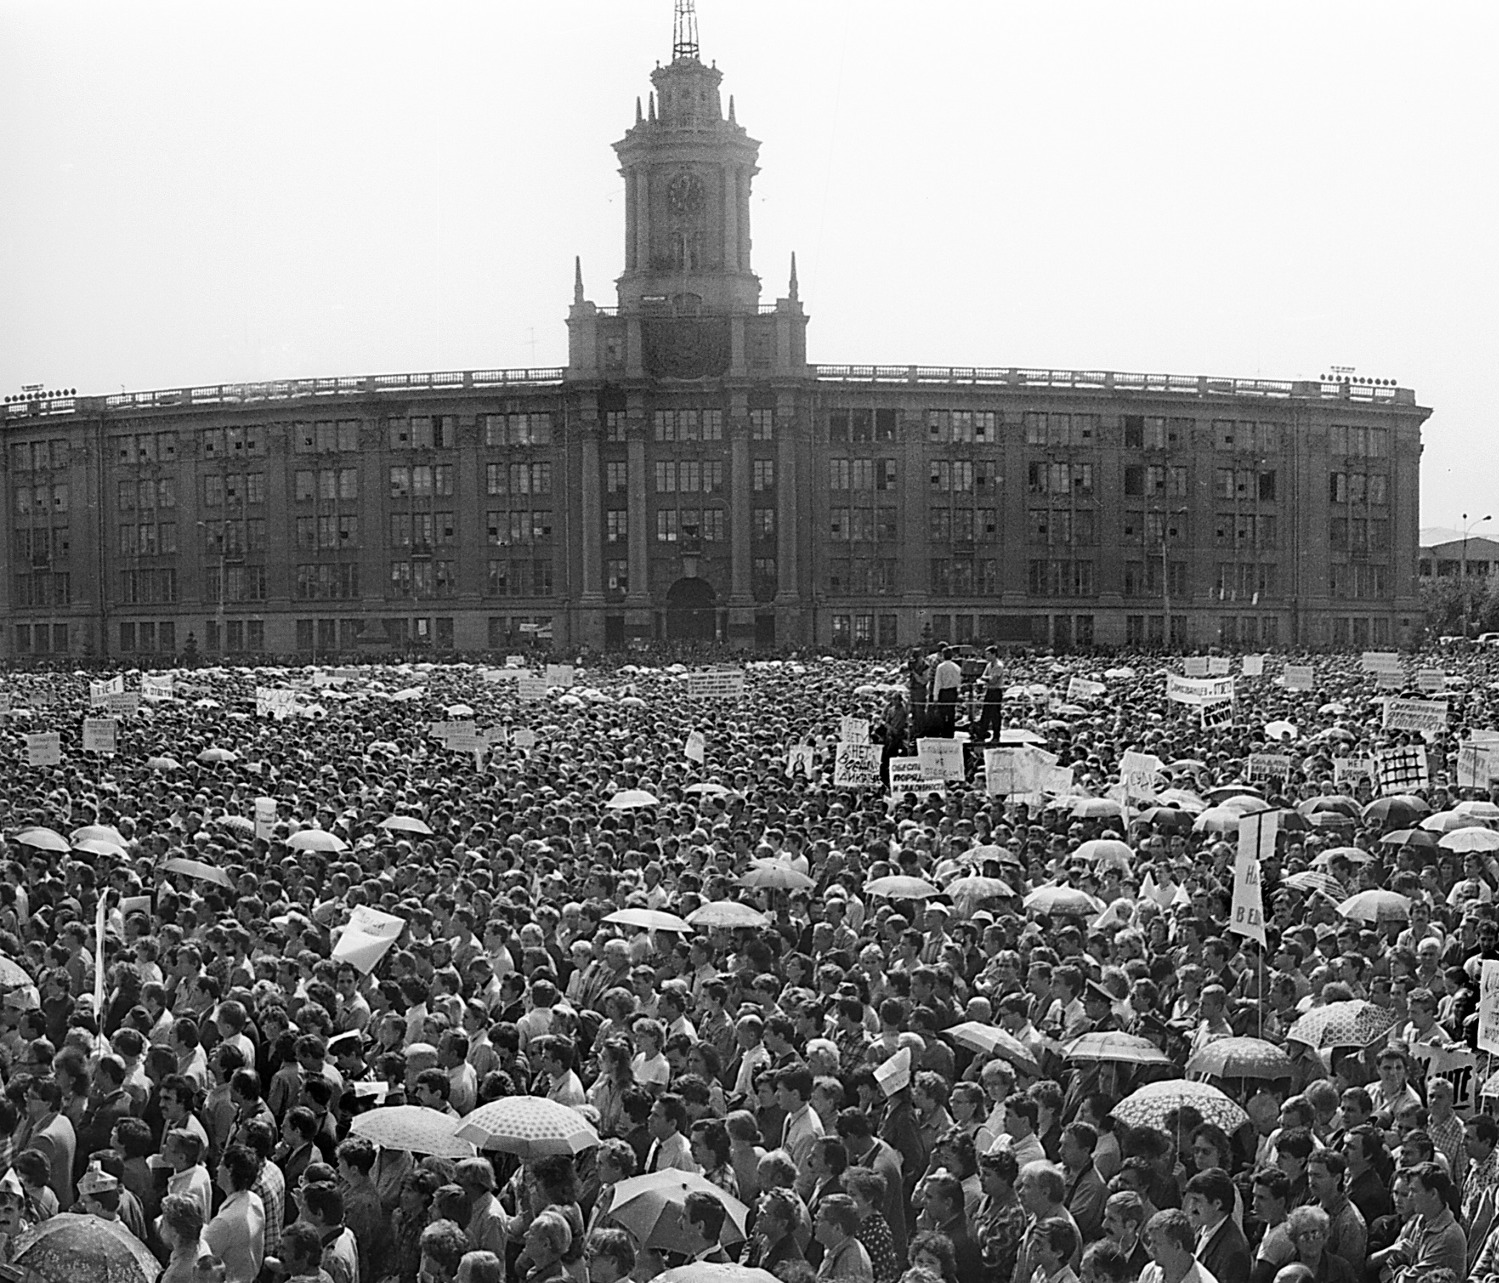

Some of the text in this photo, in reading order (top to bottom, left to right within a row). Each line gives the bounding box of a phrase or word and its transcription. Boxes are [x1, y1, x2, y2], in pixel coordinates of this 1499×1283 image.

[1204, 699, 1231, 715] ДОЛОЙ
[1204, 709, 1231, 726] ГКЧП
[851, 745, 871, 759] НЕТ
[1347, 759, 1364, 767] НЕТ
[893, 784, 898, 792] И
[1236, 906, 1245, 922] В
